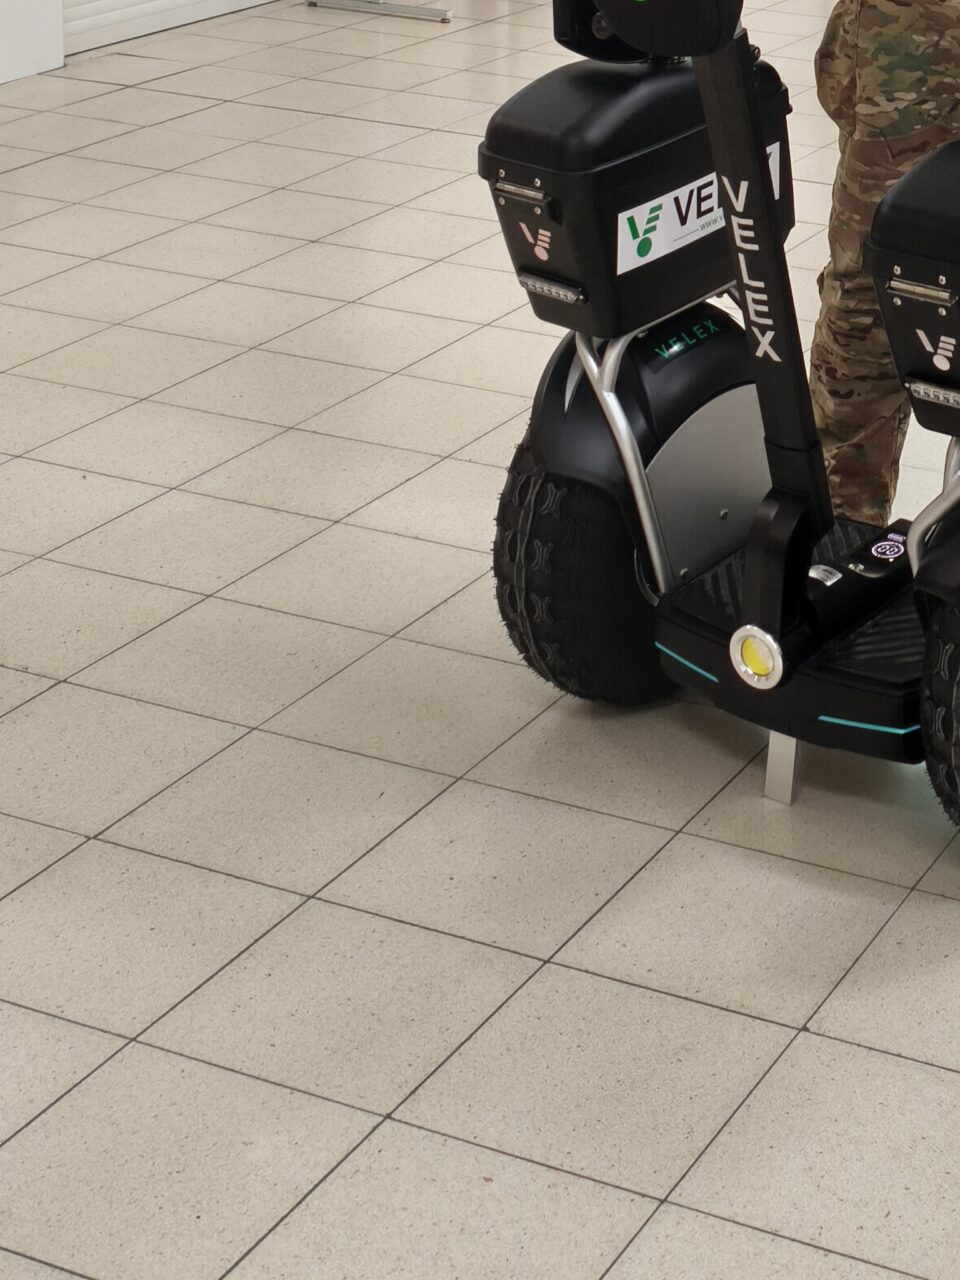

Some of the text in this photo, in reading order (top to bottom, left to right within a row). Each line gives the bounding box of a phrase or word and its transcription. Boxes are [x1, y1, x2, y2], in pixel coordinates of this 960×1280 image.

[673, 179, 719, 227] VE
[721, 175, 783, 362] VELEX
[654, 319, 720, 360] VELEX
